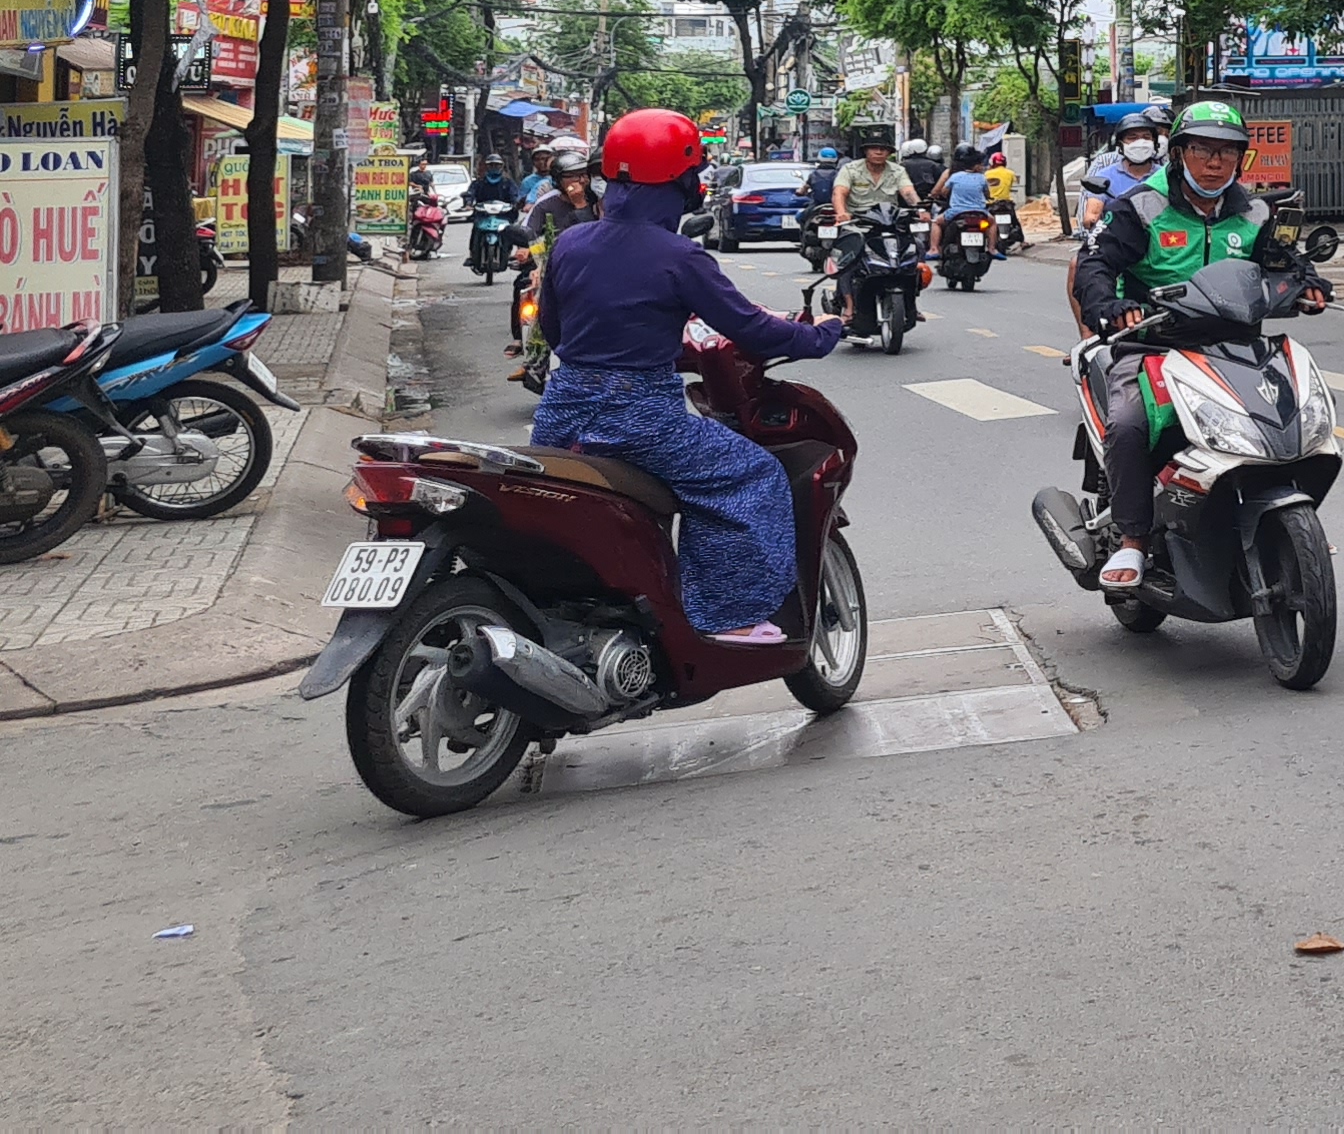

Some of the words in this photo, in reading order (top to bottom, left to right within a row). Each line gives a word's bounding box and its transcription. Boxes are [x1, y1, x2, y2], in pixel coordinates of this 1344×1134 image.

[21, 150, 106, 171] LOAN
[378, 158, 405, 167] THOA
[32, 182, 106, 262] HUẾ
[350, 547, 411, 574] 59-P3
[329, 576, 404, 603] 080.09
